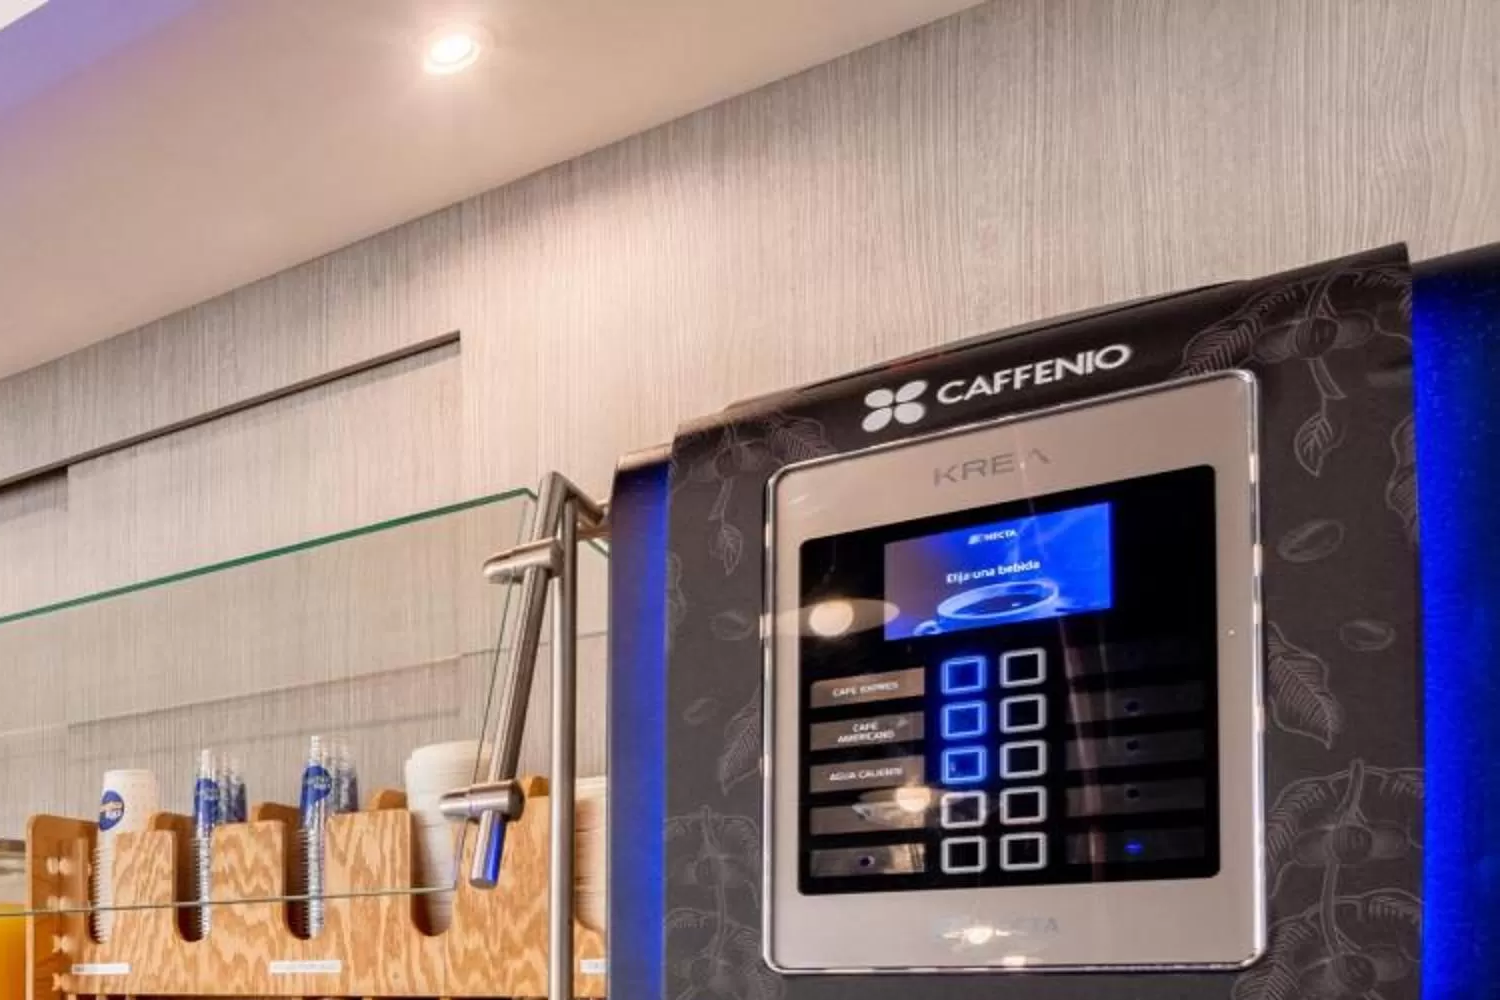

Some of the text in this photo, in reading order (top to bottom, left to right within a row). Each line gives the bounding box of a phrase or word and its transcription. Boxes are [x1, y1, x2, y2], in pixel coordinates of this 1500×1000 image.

[936, 343, 1133, 405] CAFFENIO
[933, 448, 1051, 488] KREA
[973, 568, 995, 579] una
[997, 560, 1040, 575] bebida
[837, 729, 895, 743] AMERICANO
[829, 767, 903, 782] AGUA CALIENTE
